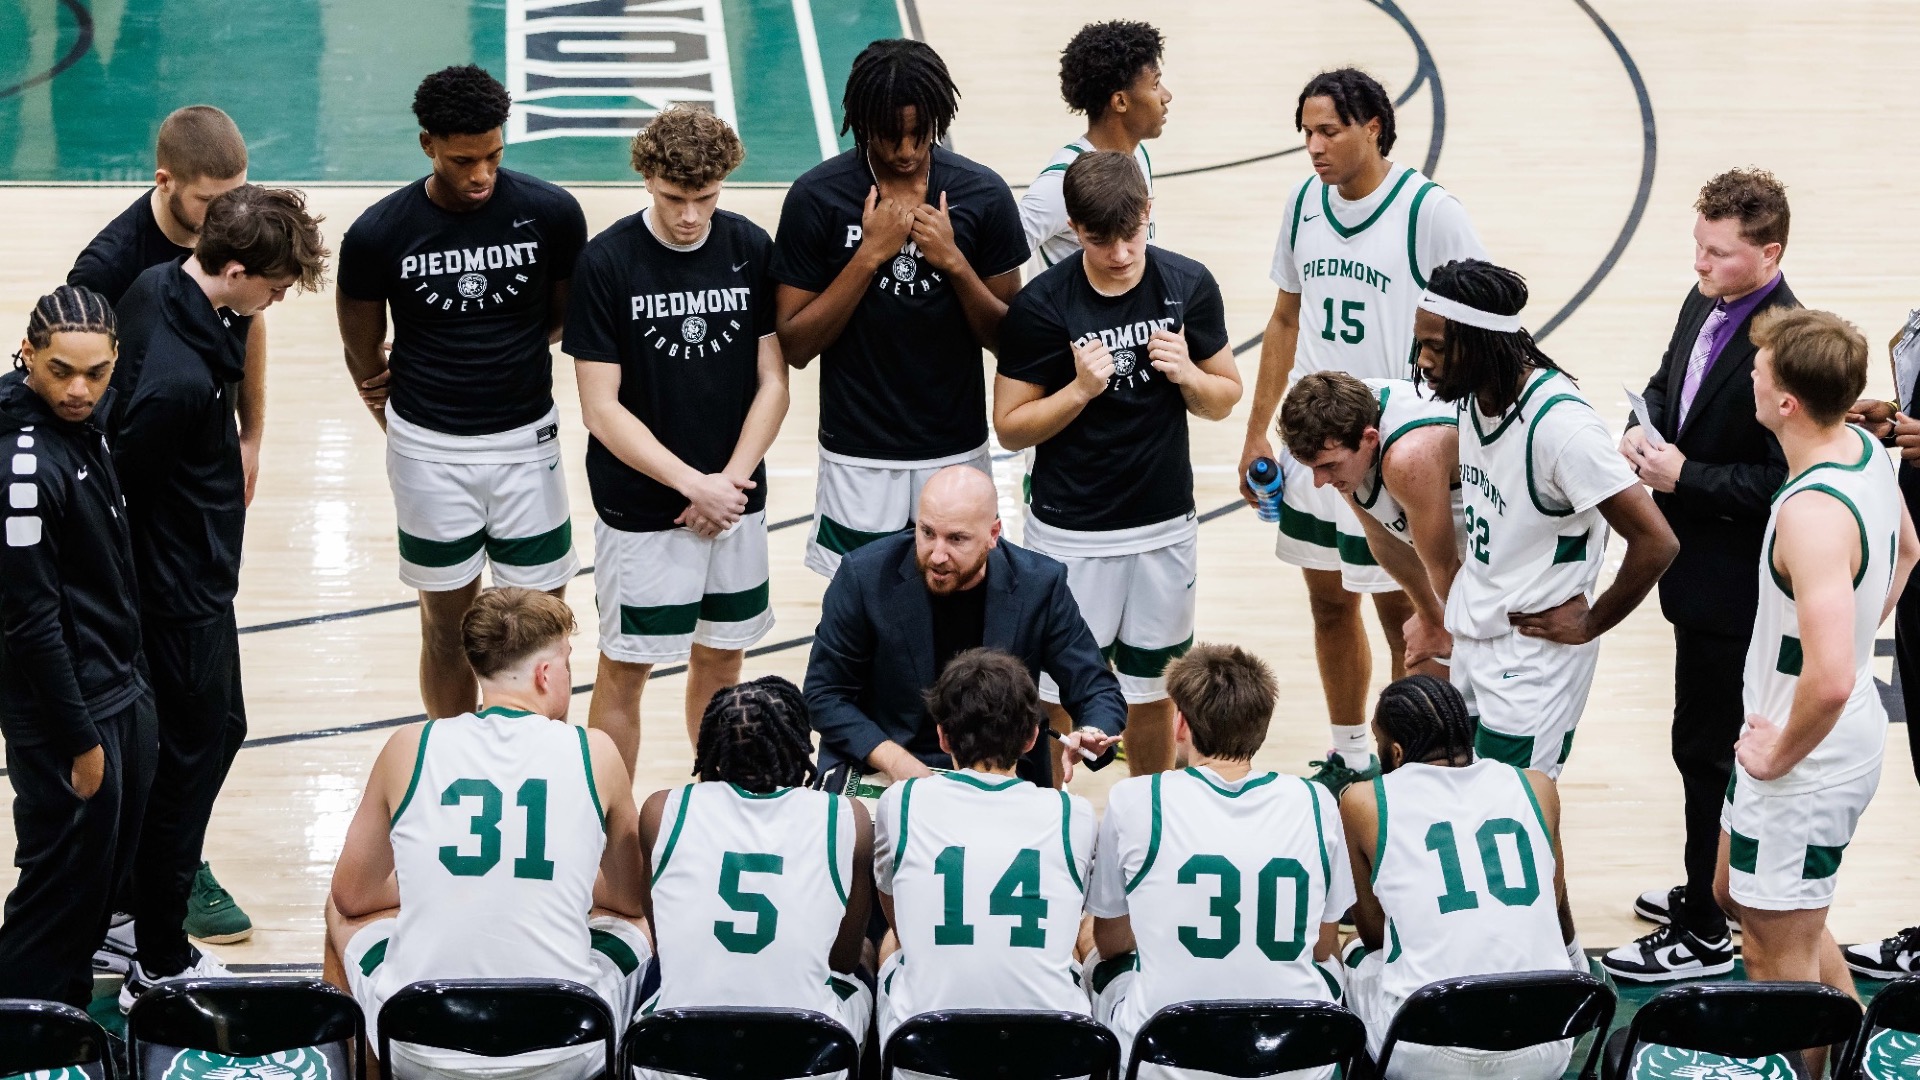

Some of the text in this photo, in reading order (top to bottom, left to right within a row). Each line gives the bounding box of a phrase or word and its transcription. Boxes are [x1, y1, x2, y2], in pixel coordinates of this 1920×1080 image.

[400, 241, 539, 280] PIEDMONT
[1303, 258, 1392, 295] PIEDMONT
[415, 272, 529, 312] TOGETHER
[631, 287, 751, 321] PIEDMONT
[875, 271, 943, 296] GETHE
[644, 319, 741, 360] TOGETHER
[1321, 297, 1366, 345] 15
[438, 777, 555, 881] 31
[1424, 817, 1541, 915] 10
[713, 851, 783, 955] 5
[933, 845, 1049, 949] 14
[1177, 853, 1311, 962] 30
